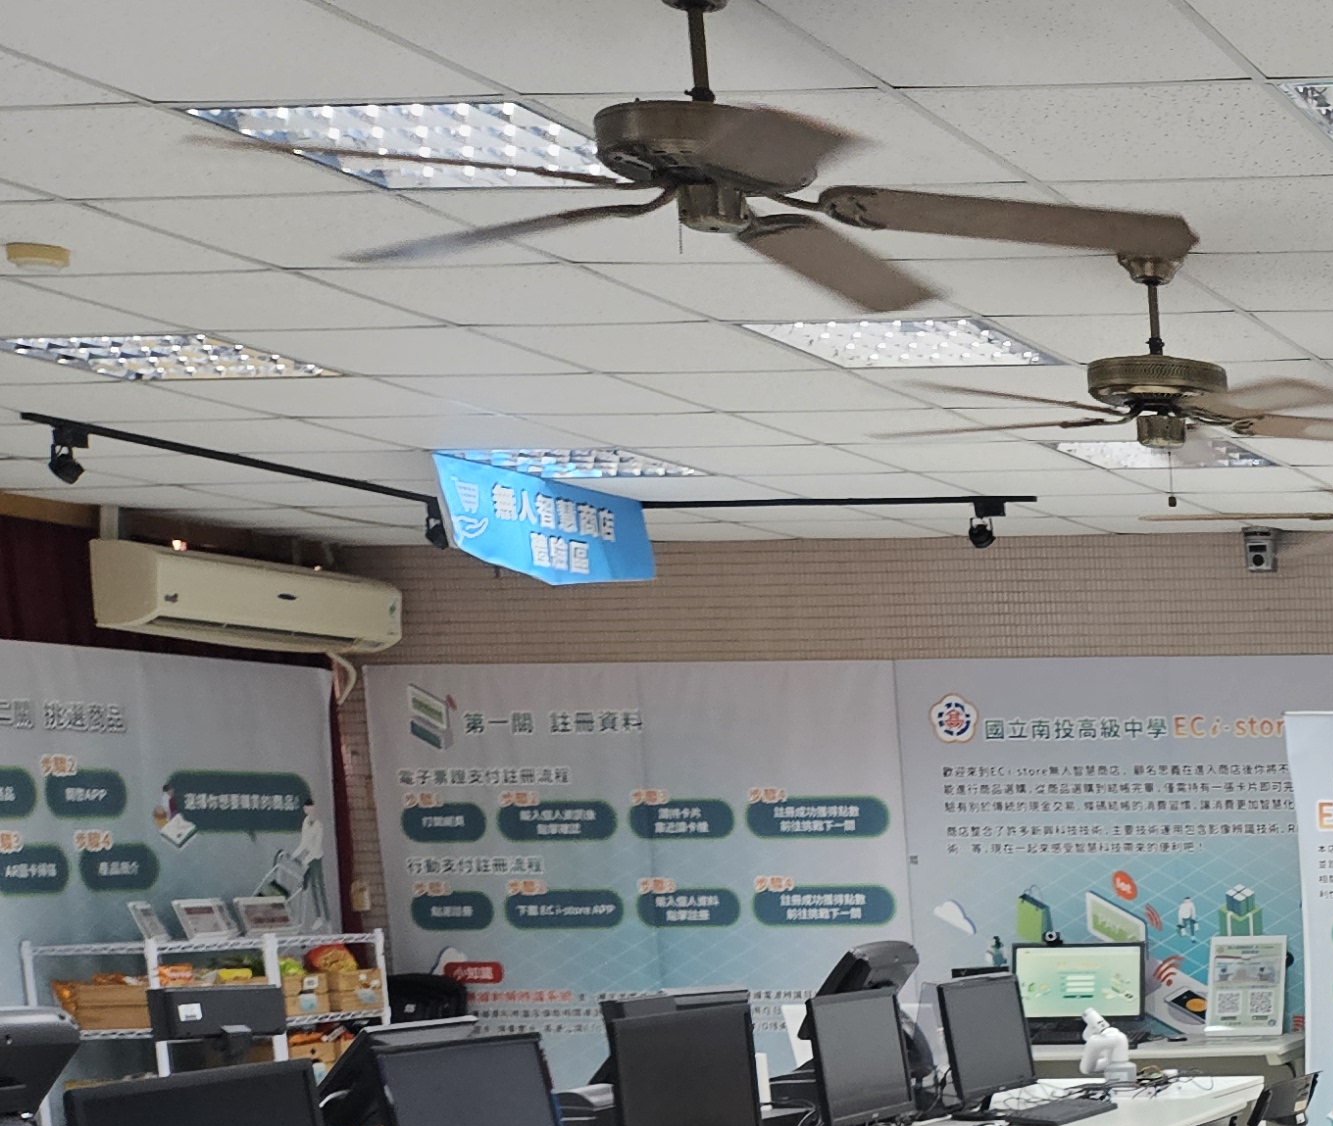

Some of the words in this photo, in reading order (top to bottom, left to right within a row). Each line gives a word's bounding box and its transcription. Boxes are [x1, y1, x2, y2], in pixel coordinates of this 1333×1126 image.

[492, 482, 616, 542] 無人智慧商店
[530, 531, 590, 574] 體驗區
[463, 711, 535, 734] 第一關
[549, 710, 643, 734] 註冊資料
[984, 717, 1167, 740] 國立南投高級中學
[1174, 716, 1205, 737] EC
[1211, 716, 1285, 737] i-stor
